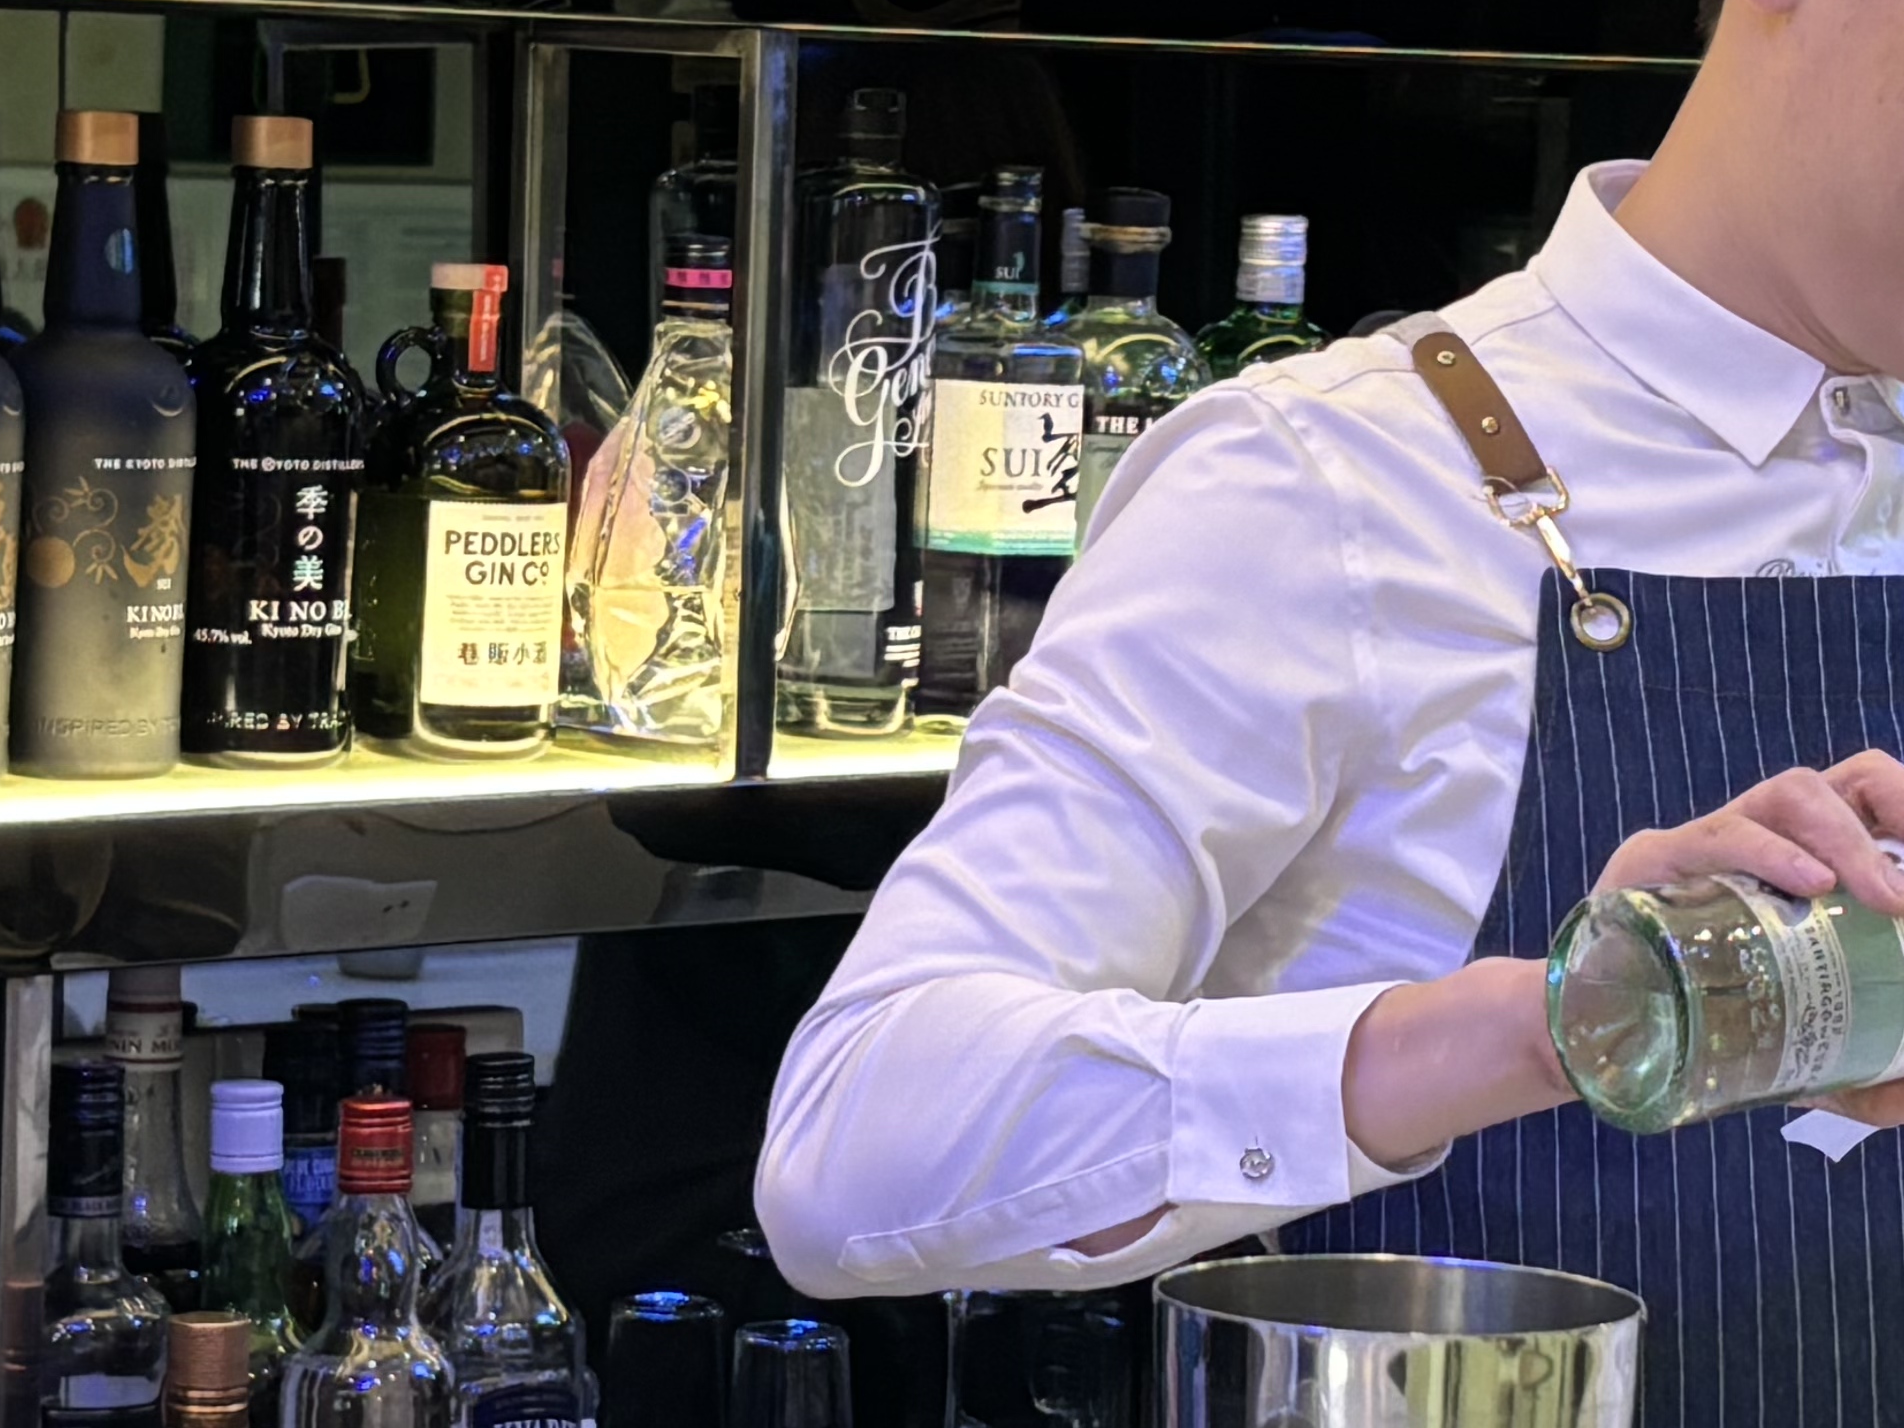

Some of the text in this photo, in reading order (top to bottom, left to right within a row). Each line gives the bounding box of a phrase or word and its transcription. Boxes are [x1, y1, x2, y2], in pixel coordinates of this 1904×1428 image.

[994, 263, 1022, 281] SUI
[978, 389, 1065, 409] SUNTORY
[1096, 414, 1140, 435] THE
[980, 445, 1043, 478] SUI
[292, 483, 330, 592] 季の美
[444, 528, 561, 558] PEDDLERS
[464, 561, 515, 586] GIN
[126, 605, 149, 623] KI
[249, 599, 280, 621] KI
[289, 599, 327, 621] NO
[261, 623, 300, 639] Kyoto
[301, 623, 323, 640] Dry
